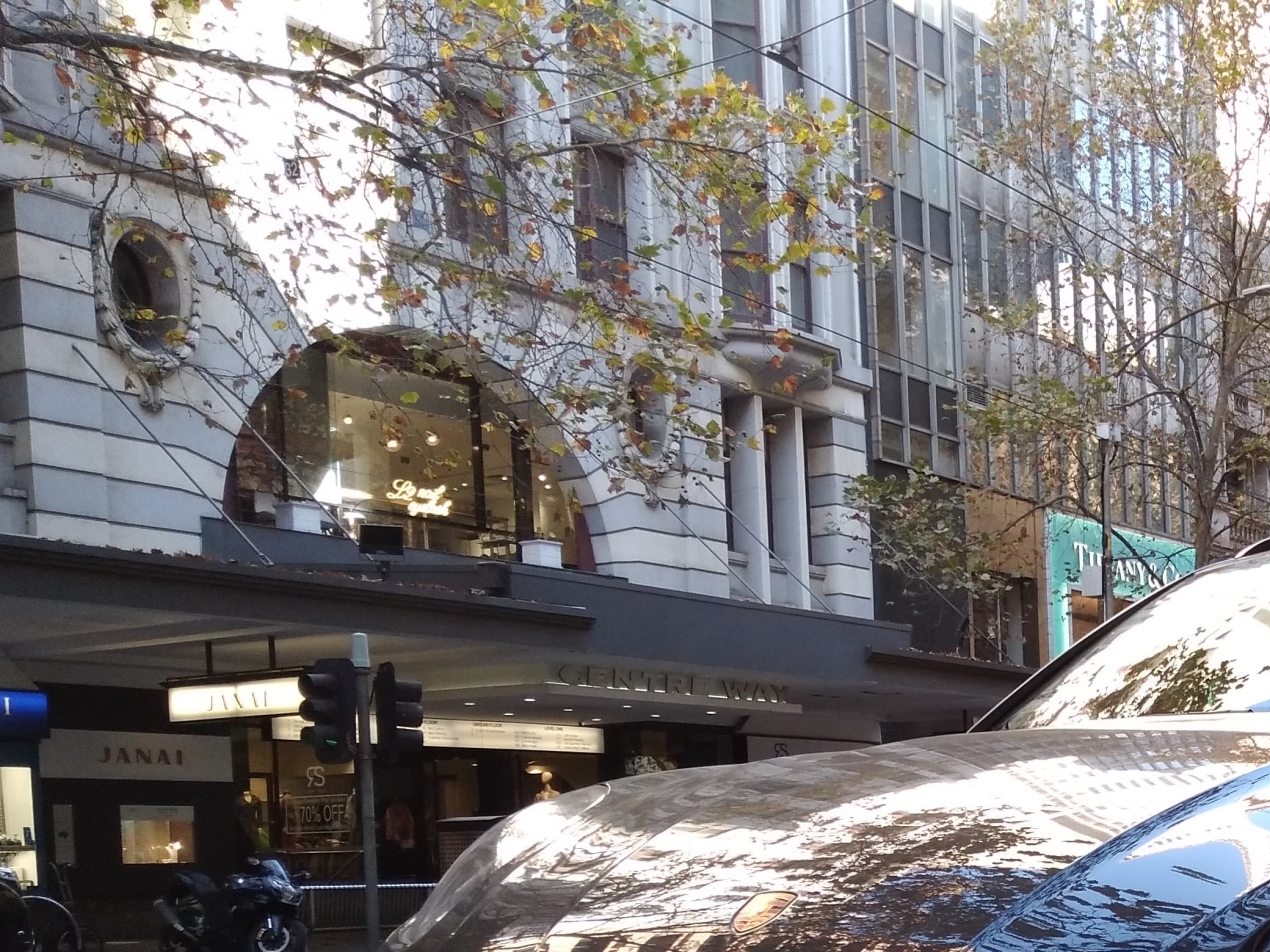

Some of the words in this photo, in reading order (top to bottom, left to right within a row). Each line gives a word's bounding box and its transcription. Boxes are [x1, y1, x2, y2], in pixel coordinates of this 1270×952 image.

[1073, 541, 1146, 586] TIANY
[558, 664, 711, 696] CENTRE
[721, 679, 790, 703] WAY
[98, 746, 183, 766] JANAI
[300, 805, 321, 822] 70%
[323, 804, 344, 822] OFF
